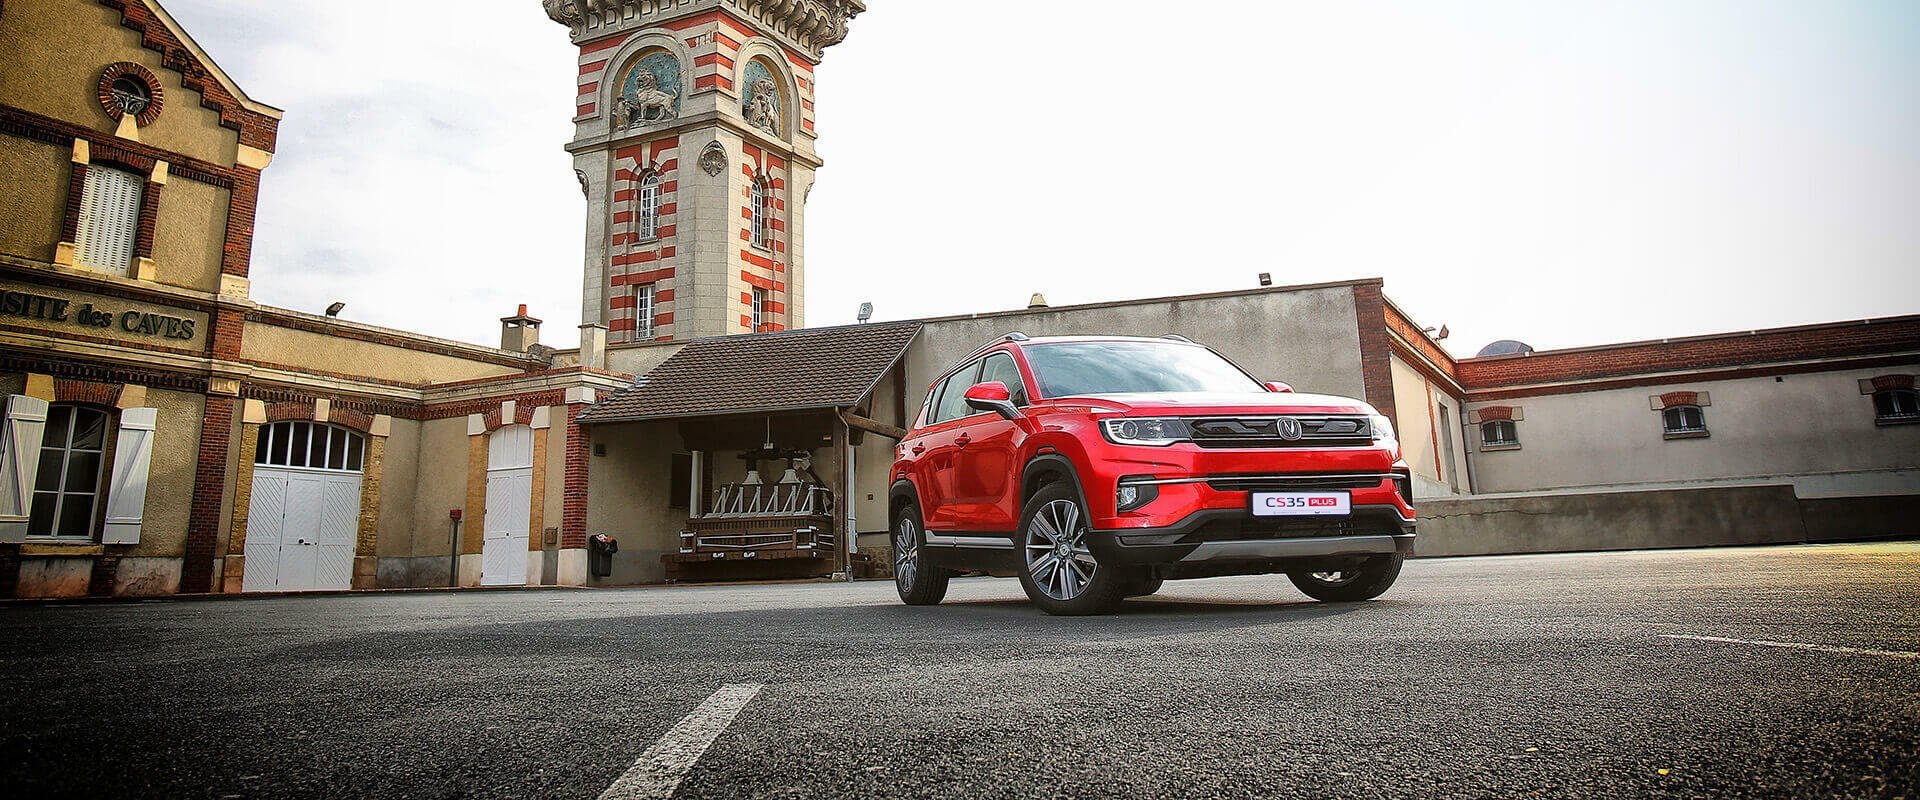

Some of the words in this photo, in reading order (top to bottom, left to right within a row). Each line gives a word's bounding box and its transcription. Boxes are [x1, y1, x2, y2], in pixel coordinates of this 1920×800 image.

[77, 303, 113, 328] des
[121, 310, 195, 340] CAVES
[1265, 497, 1305, 508] CS35
[1310, 498, 1334, 506] PLUS
